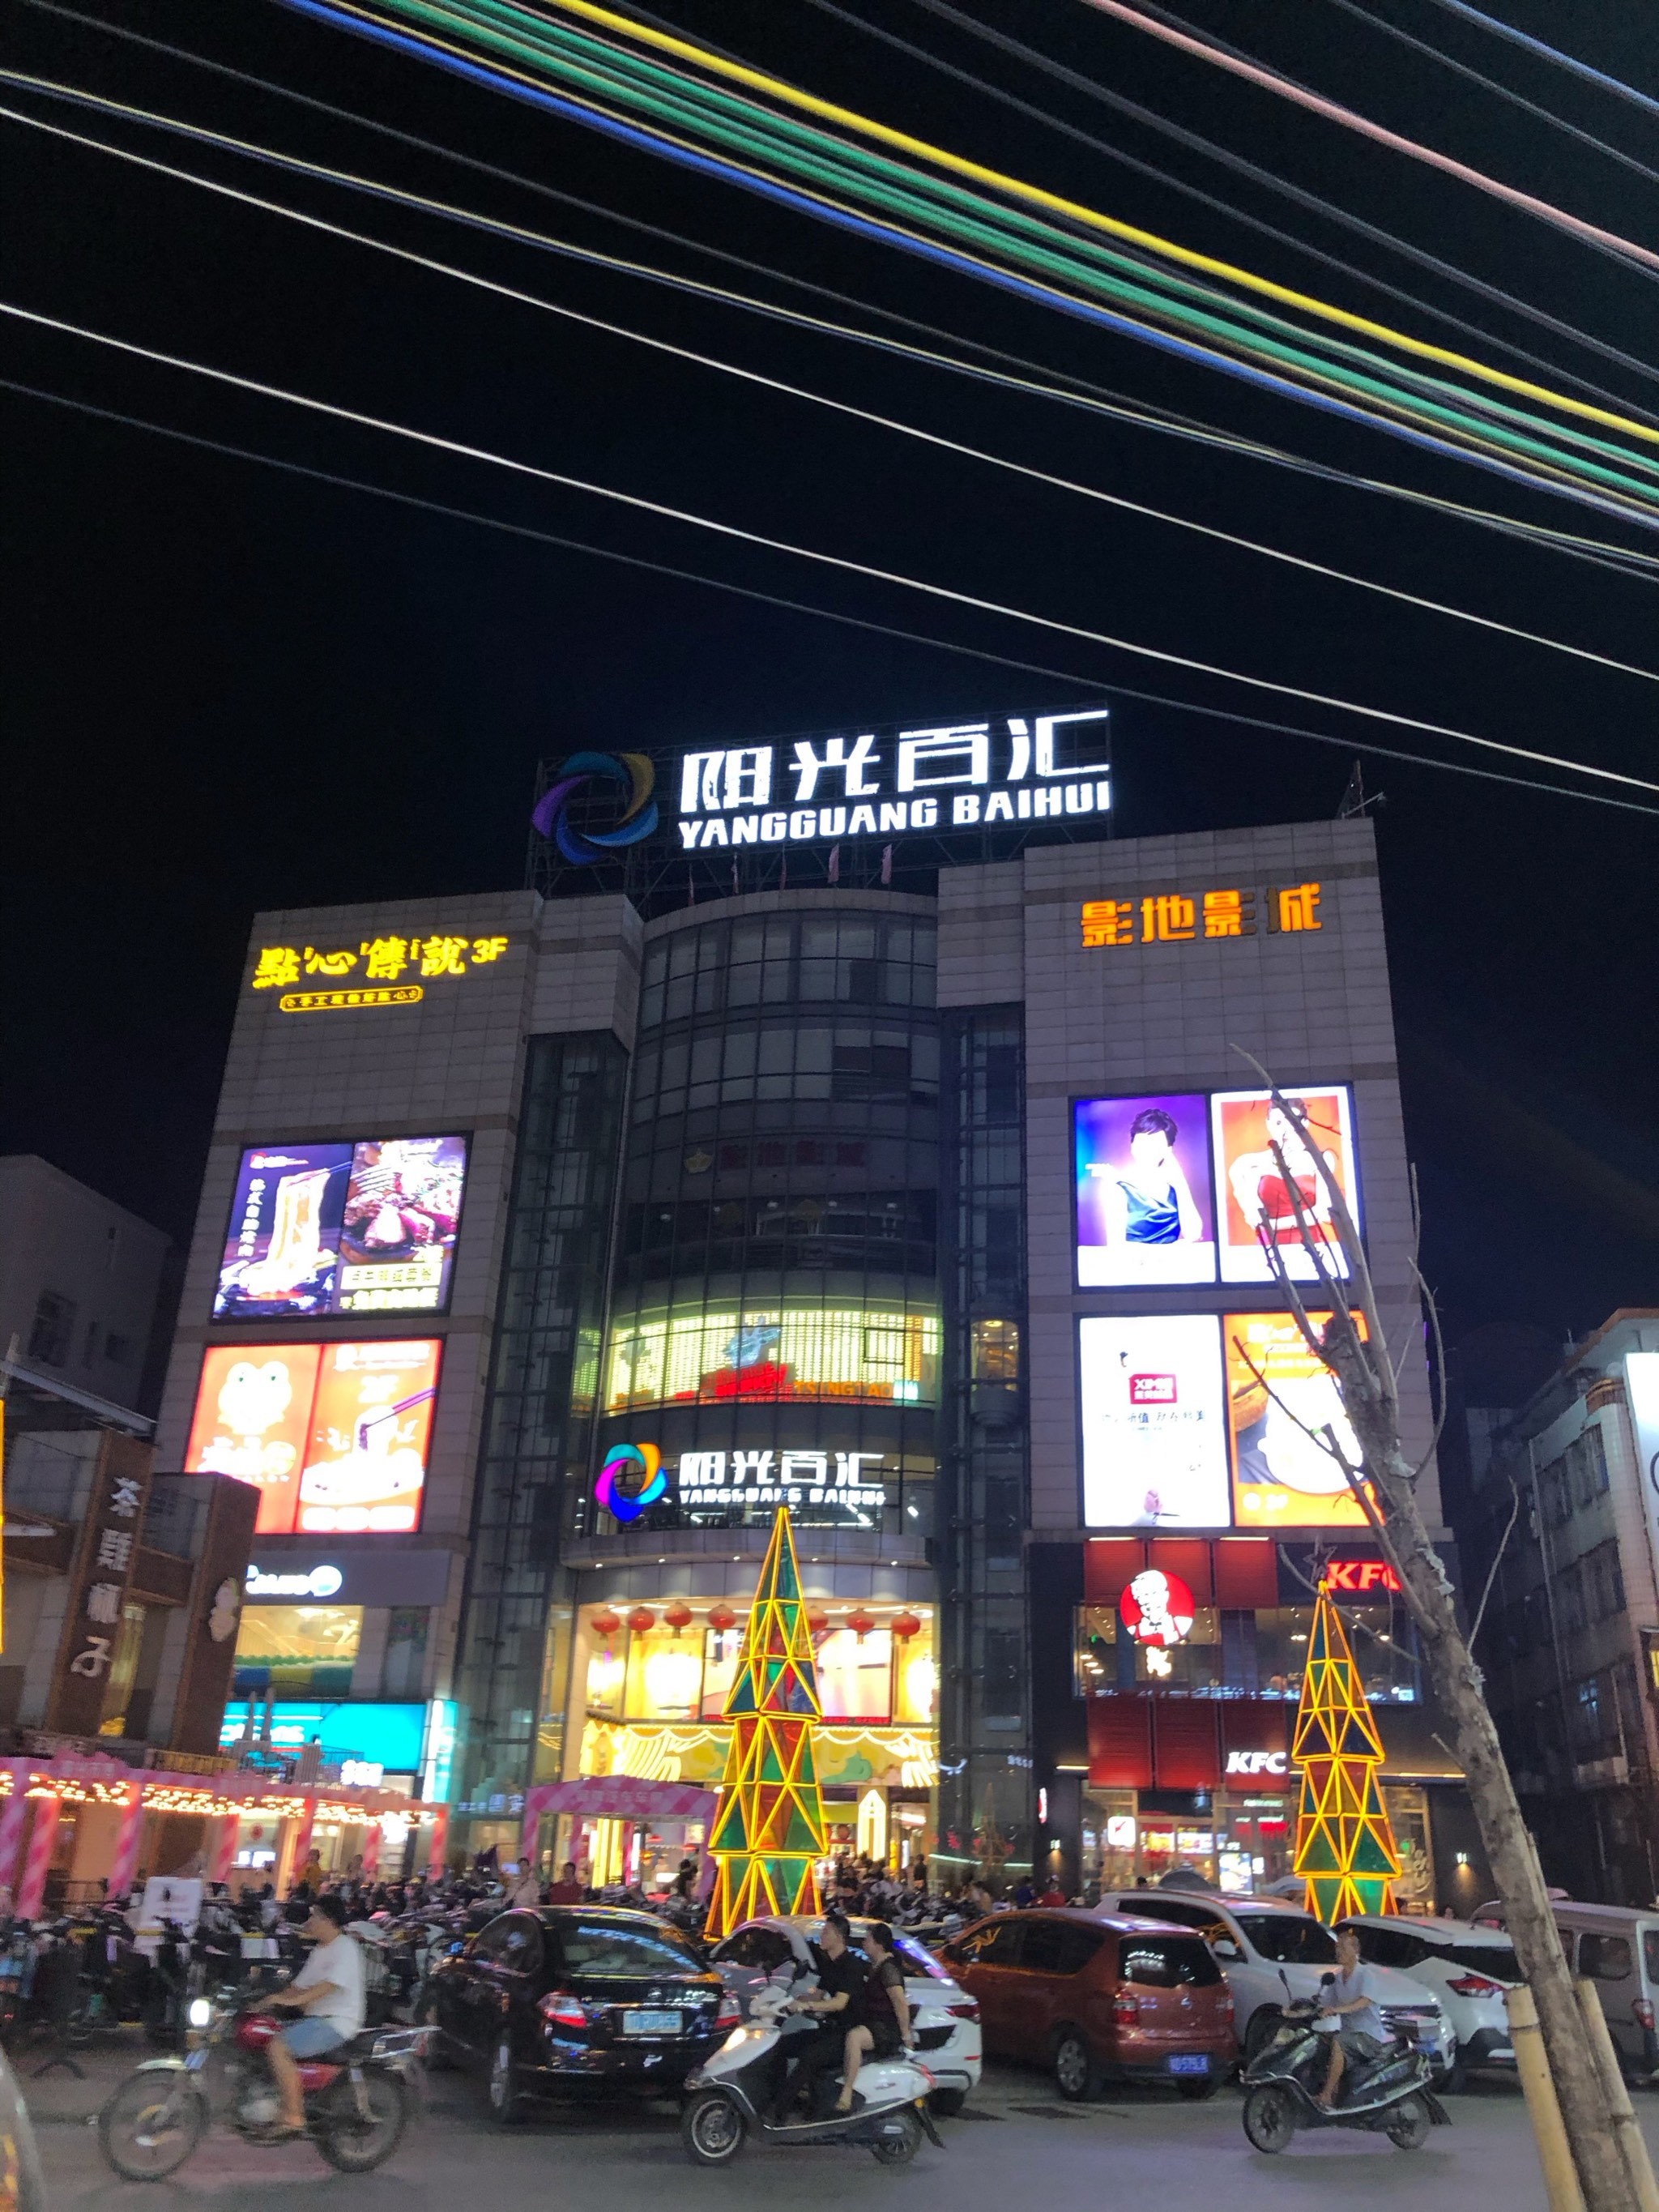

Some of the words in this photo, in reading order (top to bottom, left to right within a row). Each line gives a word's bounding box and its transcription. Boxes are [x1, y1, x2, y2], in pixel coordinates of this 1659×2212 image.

[680, 709, 1110, 813] 阳光百汇
[678, 796, 937, 850] YANGGUANG
[953, 780, 1111, 825] BAIHUI
[471, 937, 509, 964] 3F
[679, 1450, 885, 1488] 阳光百汇
[1225, 1751, 1287, 1774] KFC
